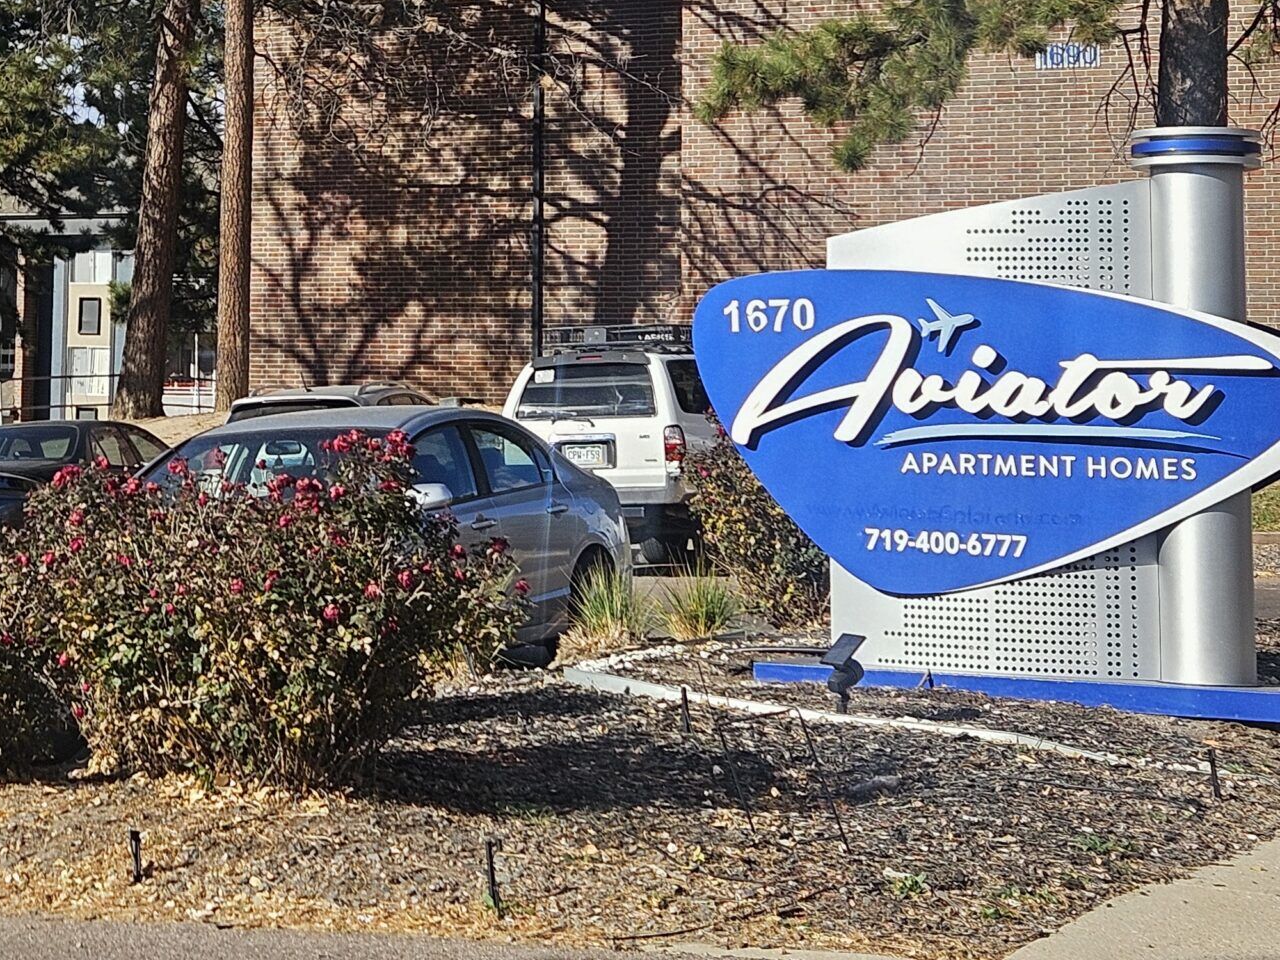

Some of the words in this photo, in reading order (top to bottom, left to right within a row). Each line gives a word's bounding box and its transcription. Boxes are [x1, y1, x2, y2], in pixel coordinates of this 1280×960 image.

[723, 297, 815, 333] 1670
[731, 314, 1274, 446] Aviator
[900, 452, 1076, 478] APARTMENT
[1087, 456, 1197, 481] HOMES
[864, 527, 1028, 558] 719-400-6777
